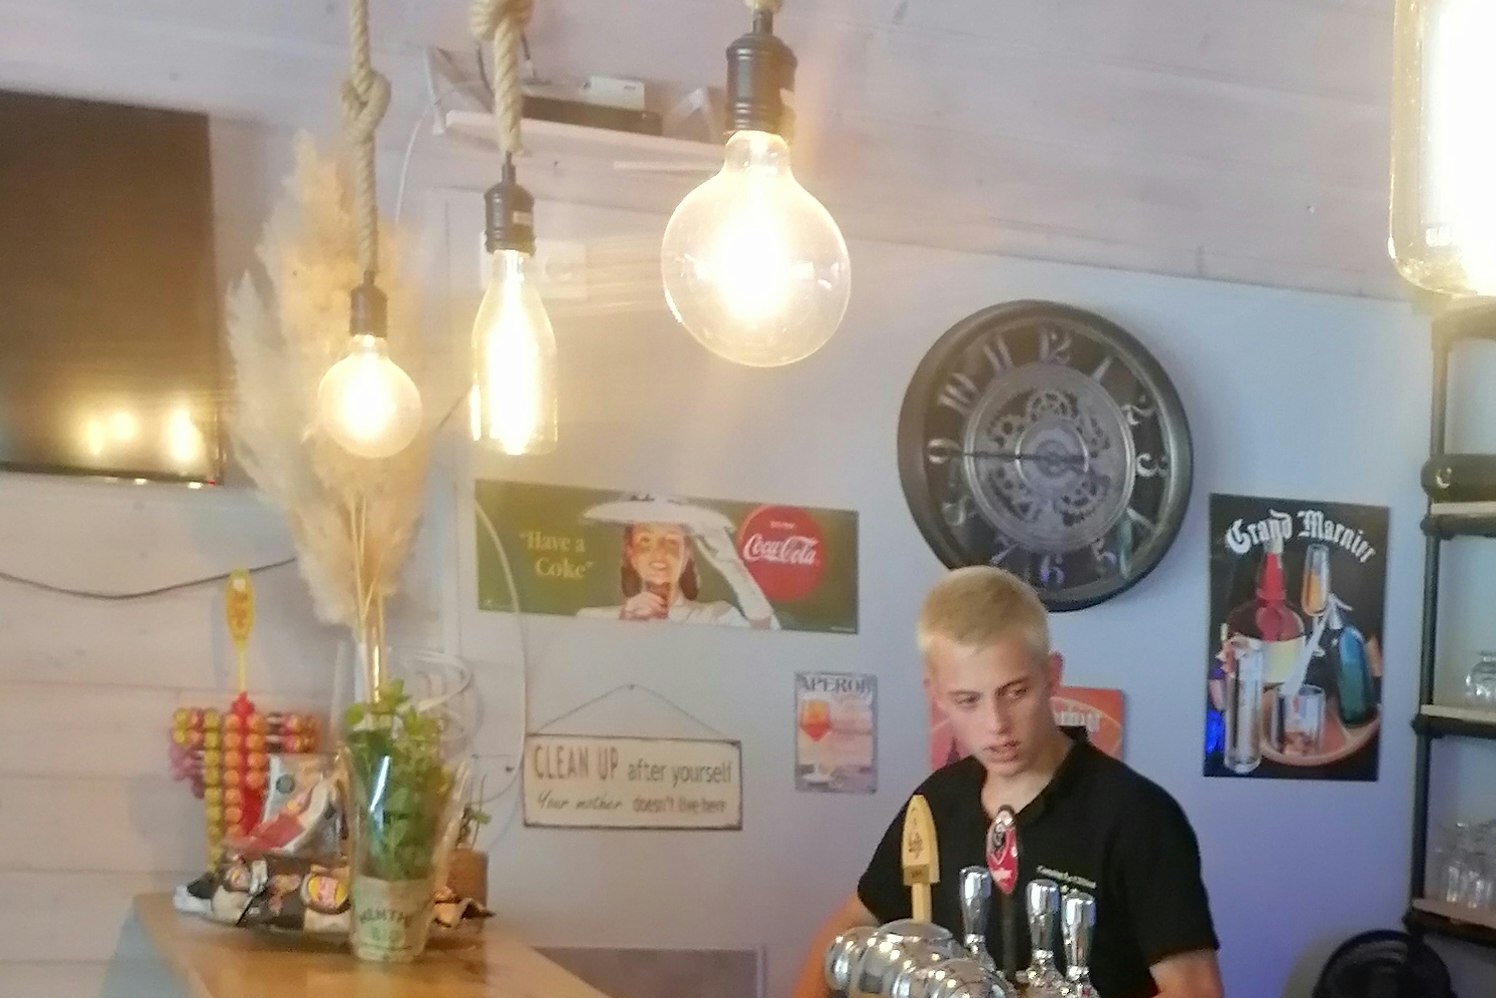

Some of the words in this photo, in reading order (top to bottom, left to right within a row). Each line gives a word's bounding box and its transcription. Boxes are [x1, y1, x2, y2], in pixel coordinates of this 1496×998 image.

[575, 537, 586, 553] a
[1226, 507, 1295, 556] Grand
[1296, 509, 1379, 564] Marnier
[534, 745, 590, 780] CLEAN
[597, 747, 619, 781] UP
[627, 759, 666, 782] after
[672, 760, 733, 787] yourself
[537, 790, 570, 811] Your
[576, 793, 624, 811] mother
[632, 796, 675, 814] doesn't
